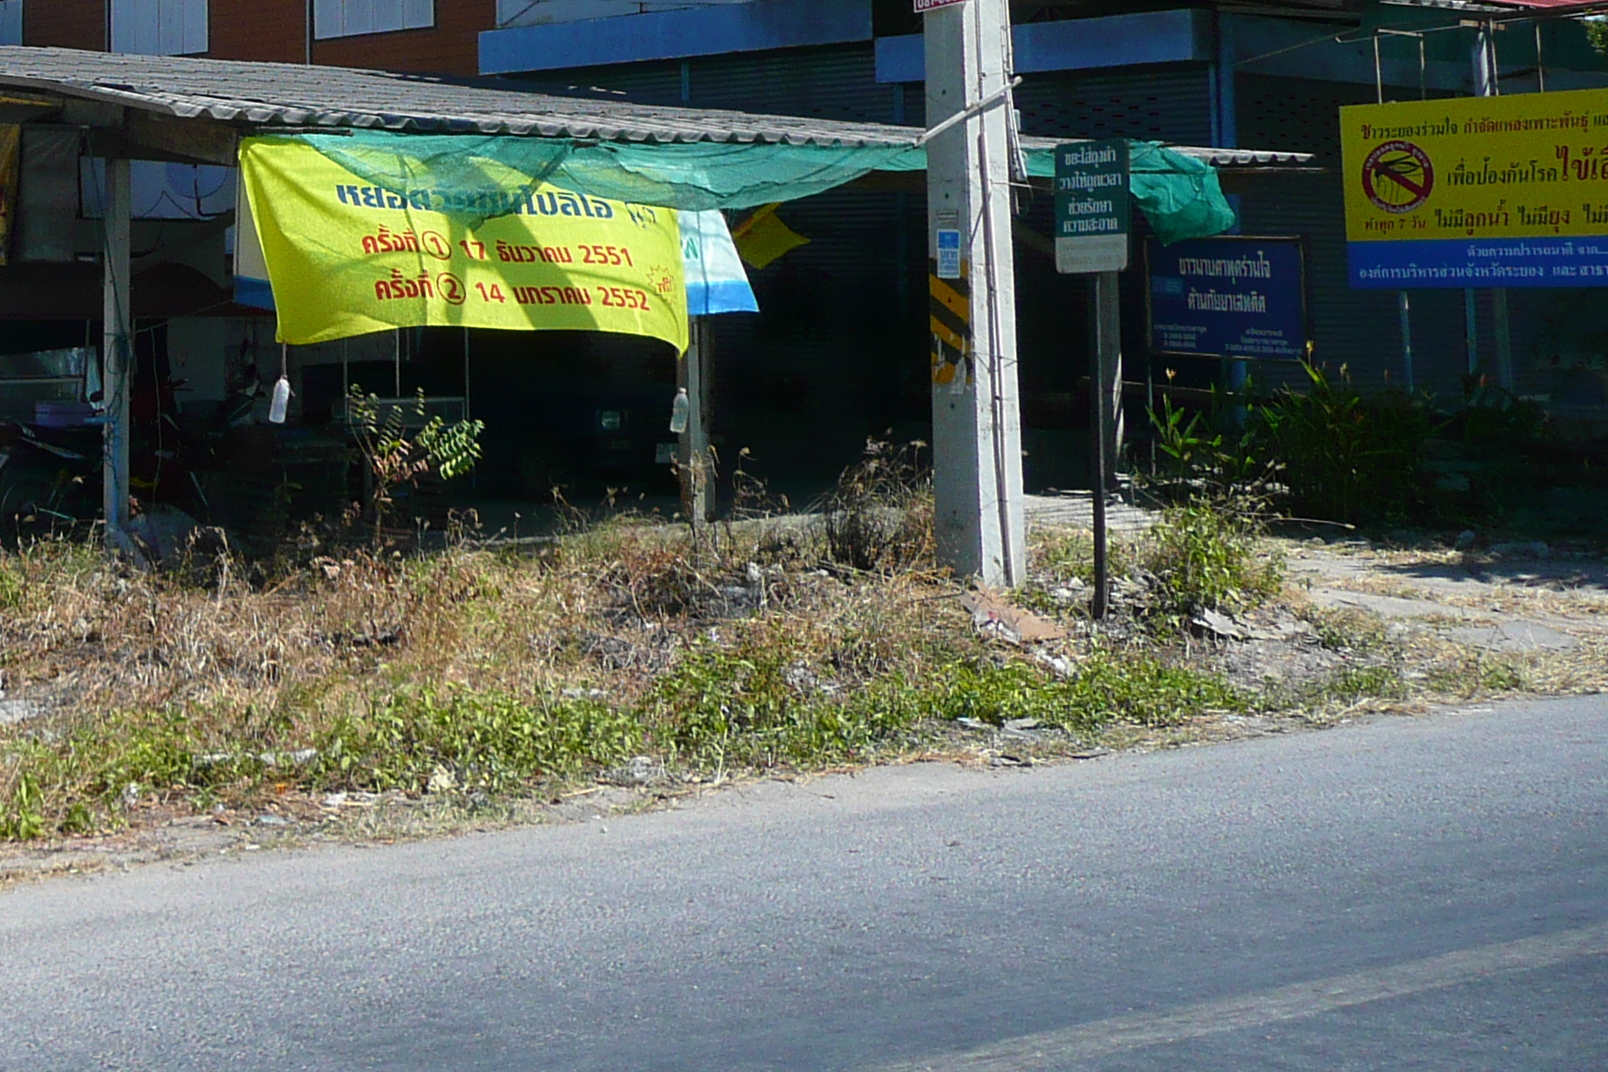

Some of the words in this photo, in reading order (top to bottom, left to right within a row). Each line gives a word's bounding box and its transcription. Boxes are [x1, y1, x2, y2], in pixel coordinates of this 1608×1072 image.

[1361, 117, 1459, 140] ชาวระยองร่วมใจ
[1434, 199, 1510, 236] ไม่มีลูกน้ำ
[1517, 204, 1571, 234] ไม่มียุง
[361, 223, 421, 255] ครั้งที่
[459, 239, 486, 261] 17
[495, 239, 574, 264] ธันวาคม
[578, 244, 634, 268] 2551
[374, 266, 435, 302] ครั้งที่
[474, 281, 506, 303] 14
[512, 285, 593, 305] มกราคม
[596, 285, 651, 312] 2552
